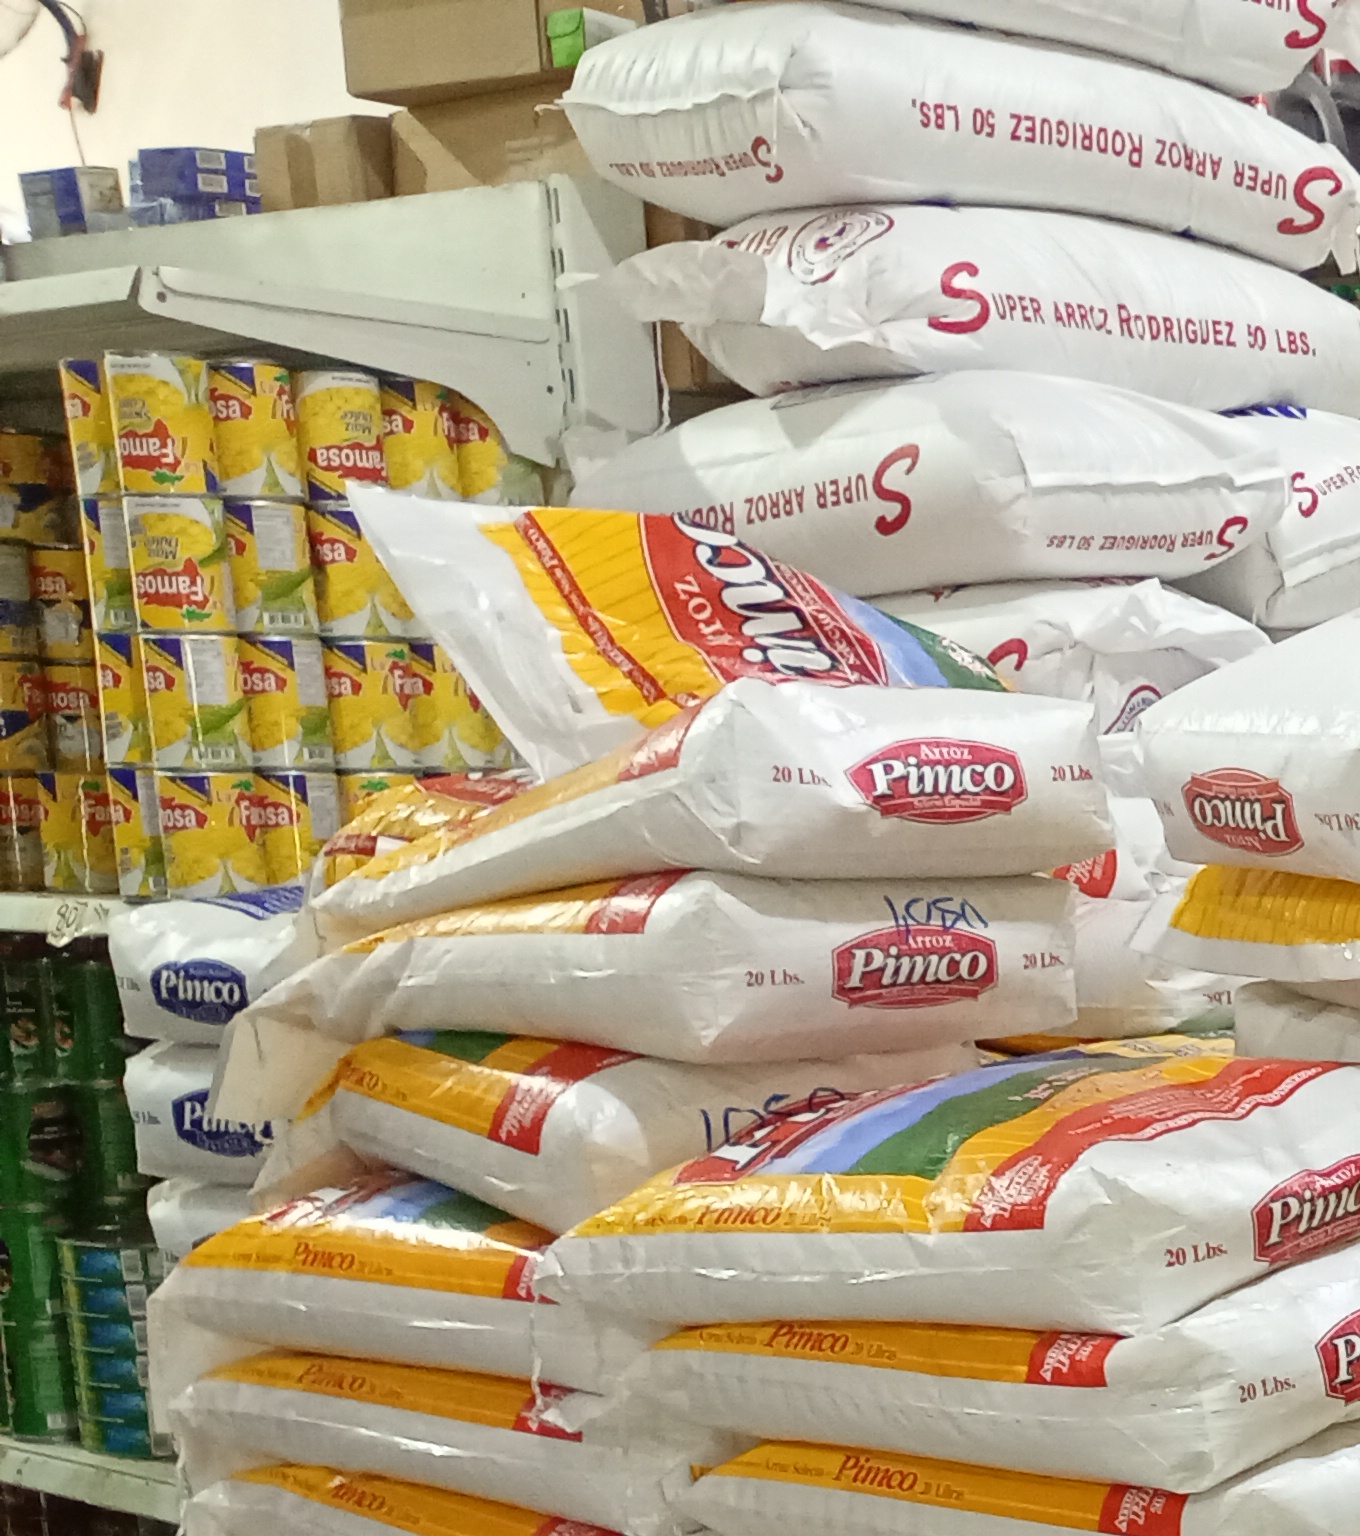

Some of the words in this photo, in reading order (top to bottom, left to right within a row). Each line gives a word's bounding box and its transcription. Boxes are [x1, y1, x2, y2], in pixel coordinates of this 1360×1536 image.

[911, 99, 963, 132] LBS.
[972, 110, 998, 135] 50
[1008, 113, 1144, 168] RODRIGUEZ
[1155, 140, 1225, 179] ARROZ
[1234, 158, 1342, 235] SUPER
[928, 262, 1044, 335] SUPER
[1118, 304, 1237, 348] RODRIGUEZ
[1277, 330, 1317, 357] LBS.
[744, 485, 806, 525] ARROZ
[814, 443, 919, 537] SUPER
[1291, 471, 1348, 519] SUPER
[1077, 534, 1095, 551] 50
[1098, 534, 1178, 553] RODRIGUEZ
[1181, 516, 1249, 561] SUPER
[920, 743, 972, 761] Arroz
[772, 766, 792, 783] 20
[871, 758, 1016, 797] Pimco
[1194, 792, 1288, 841] Pimco
[158, 968, 241, 1008] Pimco
[745, 971, 765, 988] 20
[768, 970, 805, 987] Lbs.
[848, 949, 989, 990] Pimco
[1313, 1162, 1360, 1192] Arroz
[1164, 1247, 1188, 1267] 20
[1192, 1242, 1228, 1265] Lbs.
[764, 1323, 849, 1355] Pimco
[1238, 1383, 1257, 1403] 20
[1260, 1376, 1296, 1398] Lbs.
[834, 1454, 918, 1491] Pimco
